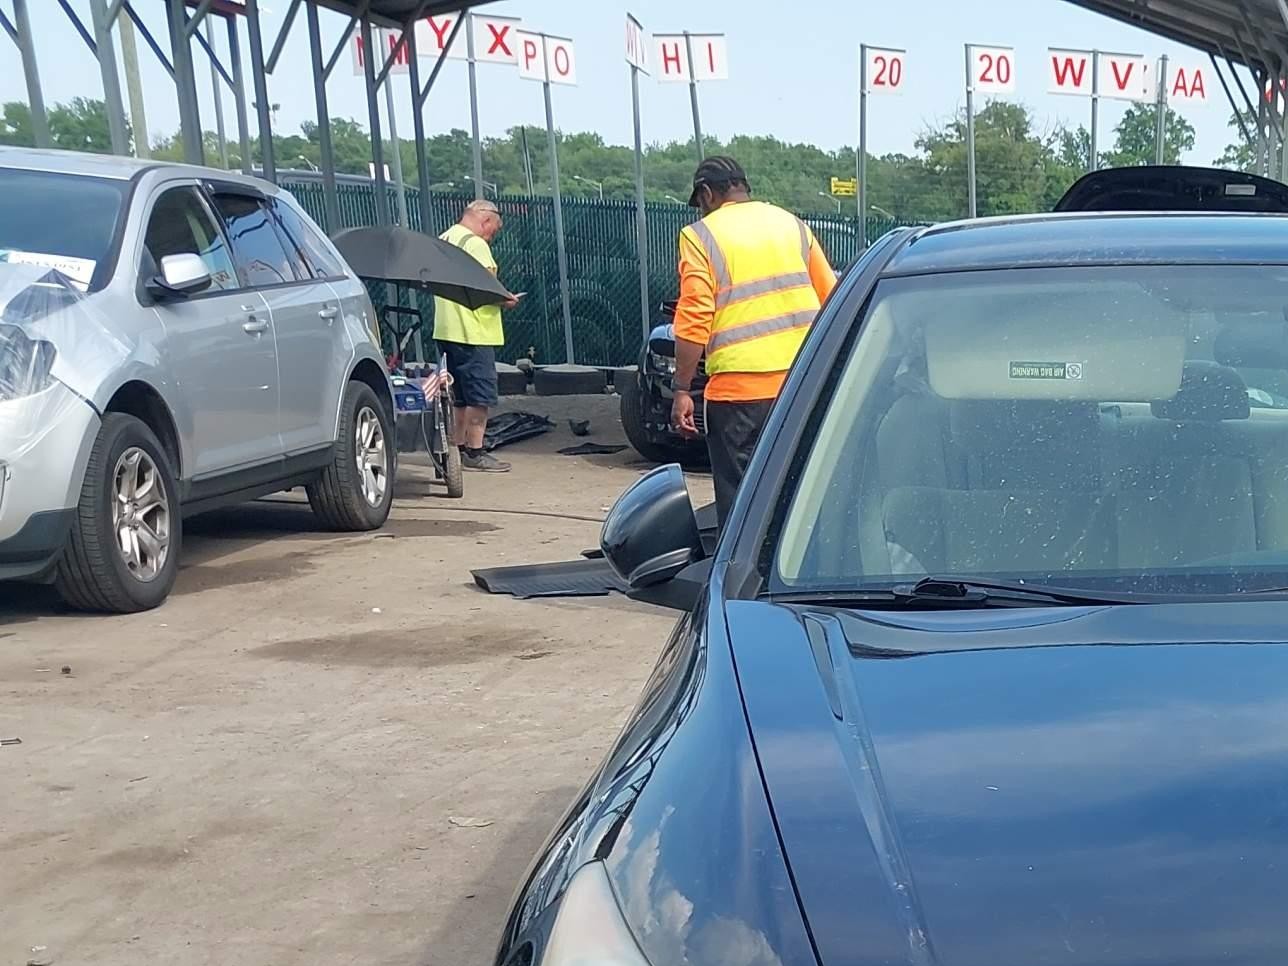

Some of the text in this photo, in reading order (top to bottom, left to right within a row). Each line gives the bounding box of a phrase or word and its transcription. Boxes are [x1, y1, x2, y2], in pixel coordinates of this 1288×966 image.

[426, 15, 512, 56] Y X
[524, 40, 569, 75] P O
[662, 43, 681, 74] H
[873, 56, 901, 87] 20
[979, 54, 1011, 84] 20
[1052, 57, 1086, 87] W
[1111, 61, 1134, 91] V
[1172, 68, 1205, 98] AA
